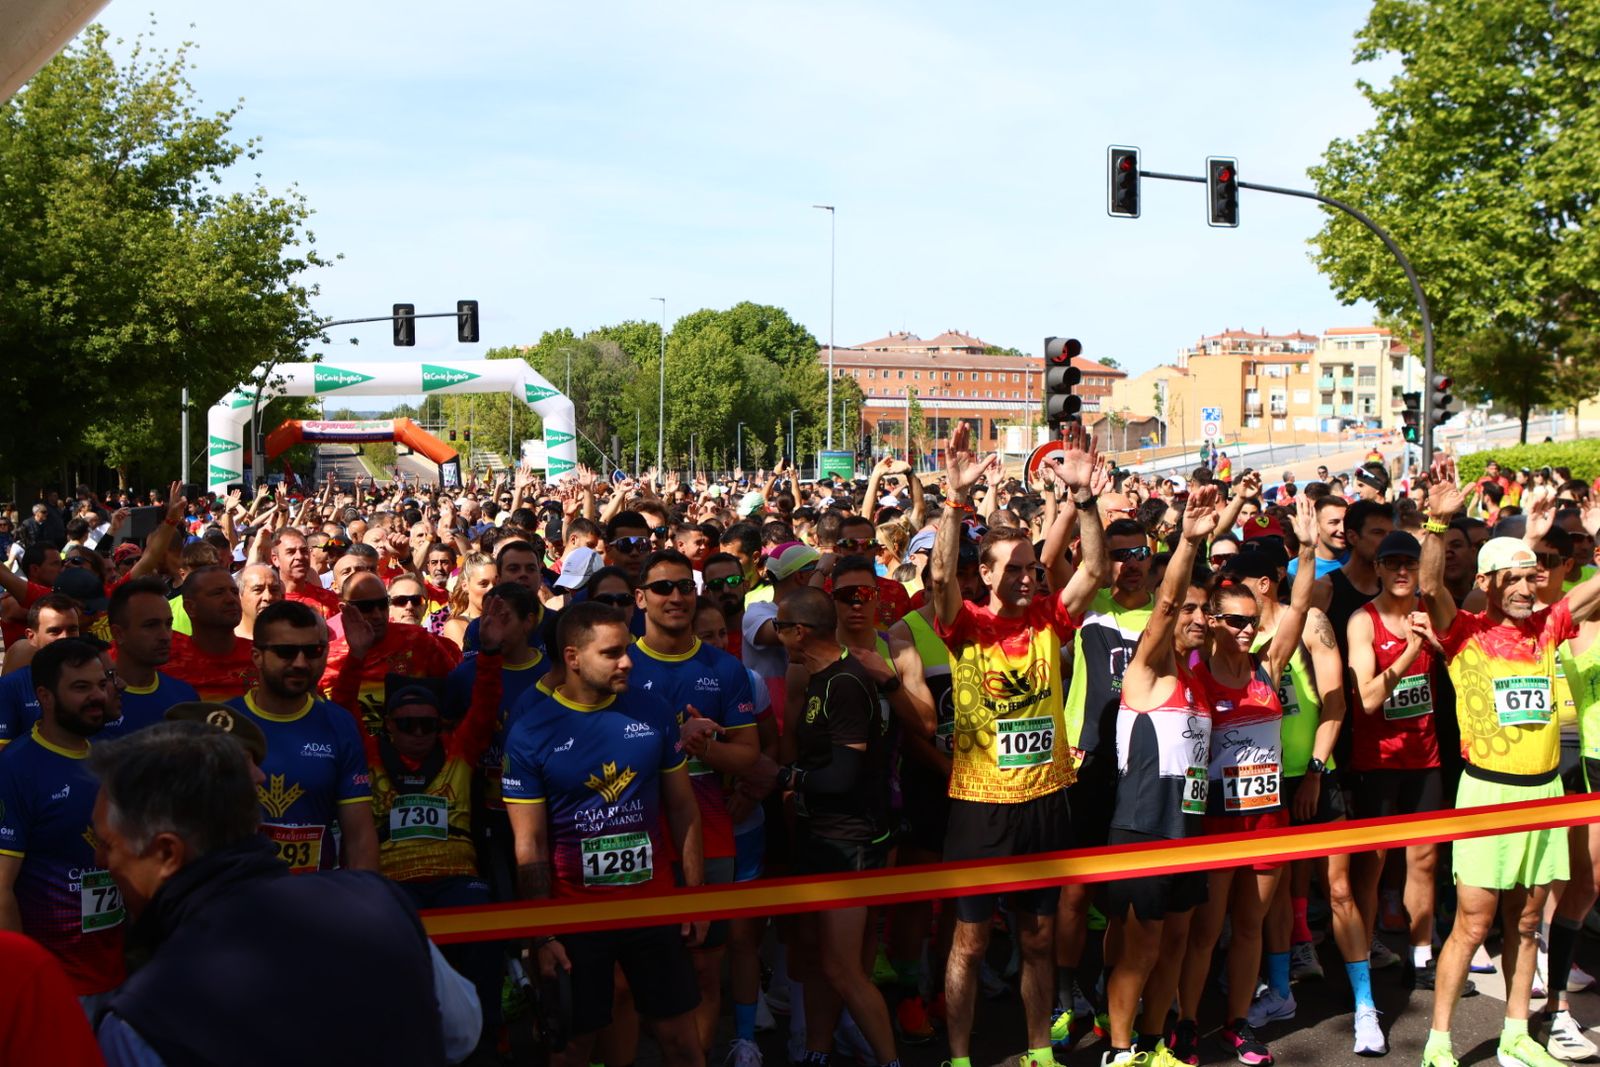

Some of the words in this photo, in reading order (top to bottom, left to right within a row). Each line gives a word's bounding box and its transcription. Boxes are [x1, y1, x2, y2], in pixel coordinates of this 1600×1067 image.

[1391, 686, 1430, 708] 1566
[1506, 690, 1546, 710] 673
[624, 731, 636, 740] Club
[625, 722, 651, 732] ADAS
[303, 742, 332, 753] ADAS
[1001, 730, 1053, 754] 1026
[1191, 780, 1208, 800] 86
[1227, 775, 1277, 797] 1735
[399, 807, 439, 827] 730
[574, 808, 605, 823] CAJA
[587, 846, 648, 876] 1281
[92, 888, 122, 913] 72
